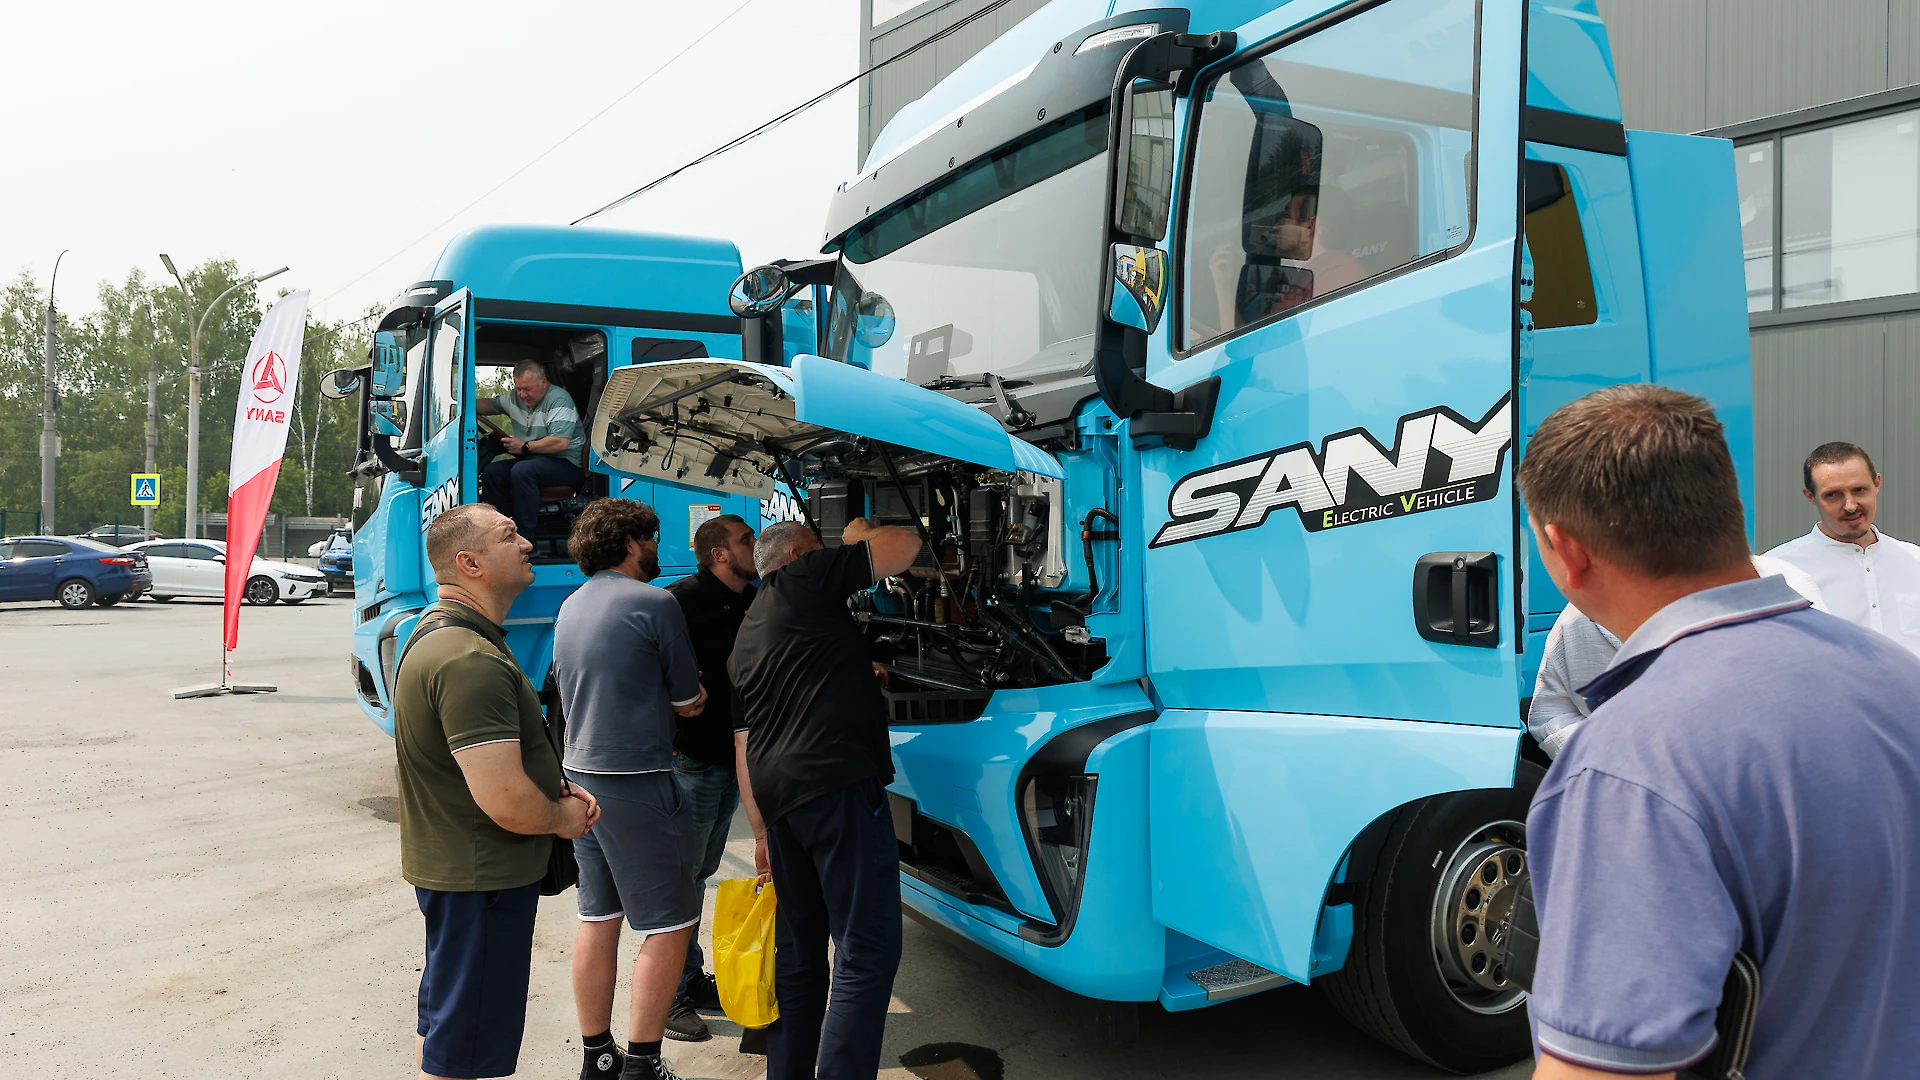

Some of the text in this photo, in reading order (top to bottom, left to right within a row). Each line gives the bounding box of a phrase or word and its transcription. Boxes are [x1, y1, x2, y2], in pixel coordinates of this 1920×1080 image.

[1351, 240, 1388, 259] SANY
[1152, 394, 1512, 547] SANY
[1322, 485, 1476, 529] ELECTRIC VEHICLE
